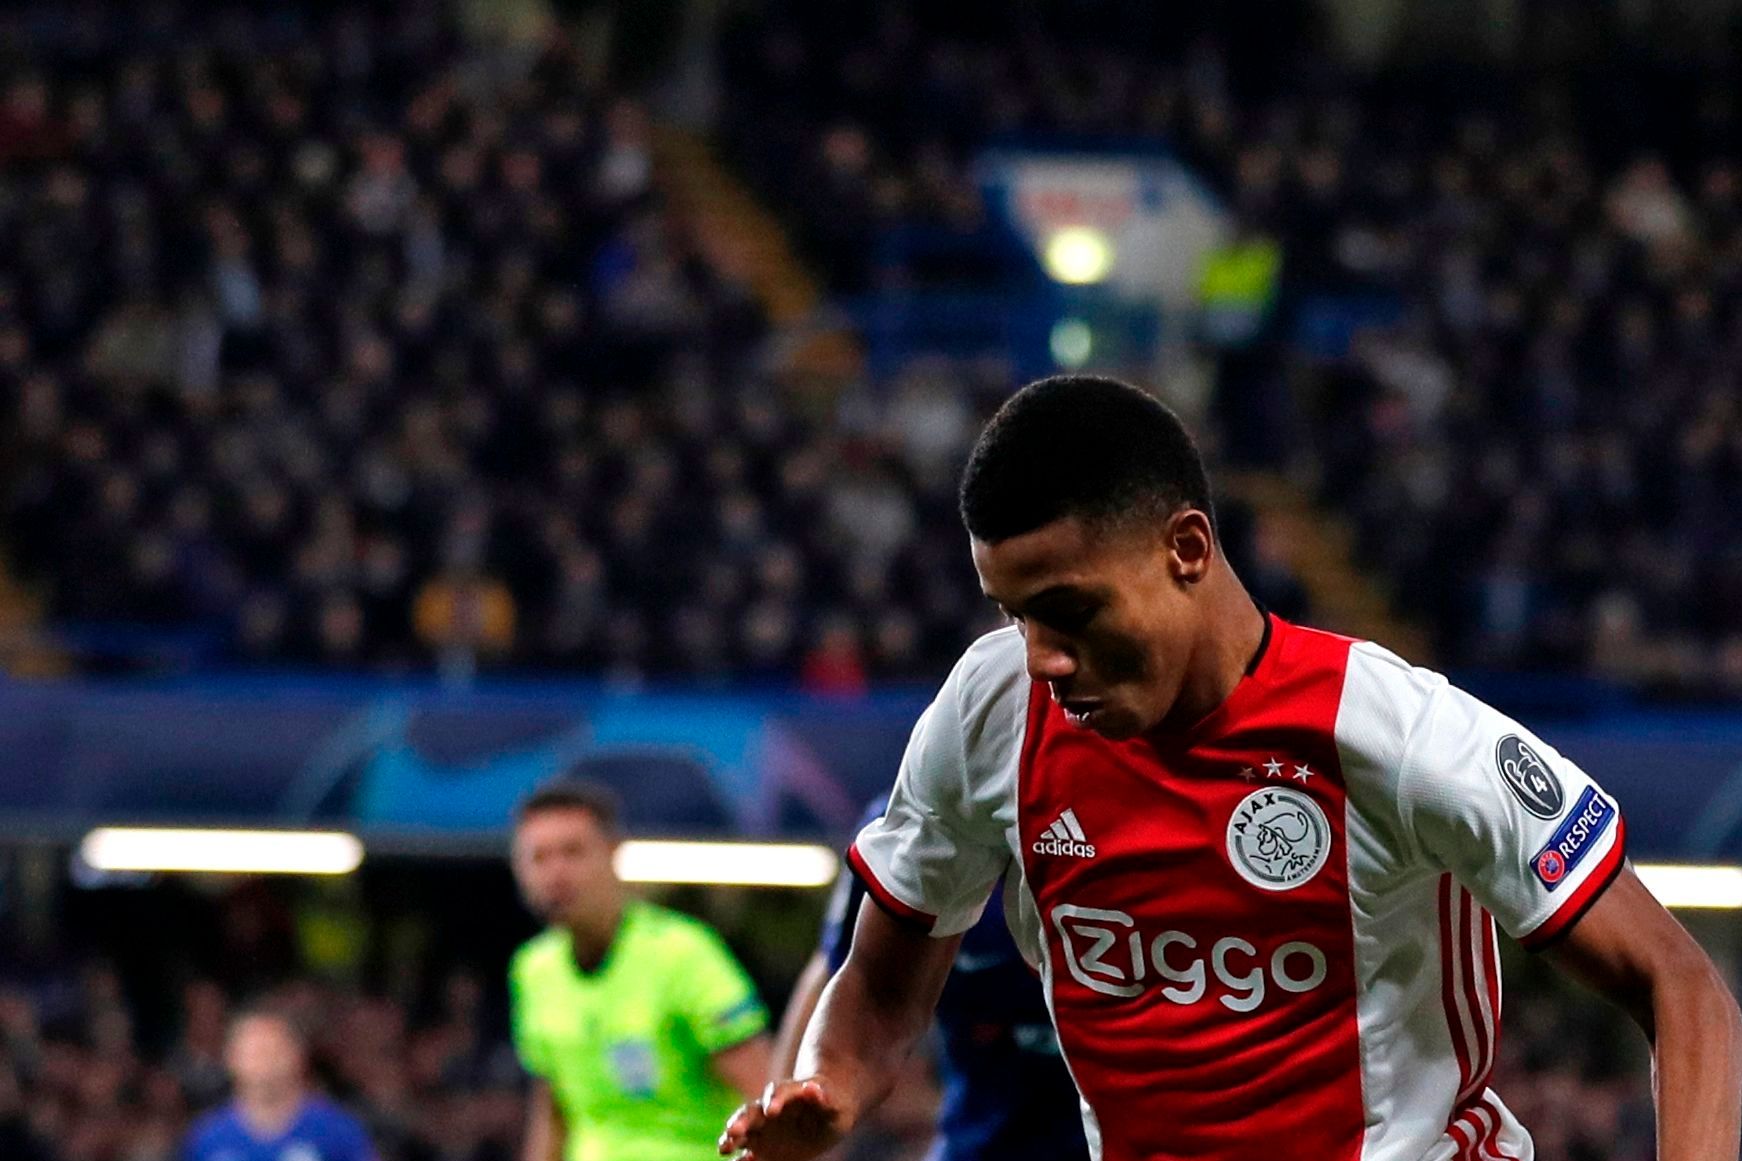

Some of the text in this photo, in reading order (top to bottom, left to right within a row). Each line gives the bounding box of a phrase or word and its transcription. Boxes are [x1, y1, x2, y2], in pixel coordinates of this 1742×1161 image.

[1530, 775, 1547, 793] 4
[1234, 793, 1276, 834] AJAX
[1558, 793, 1606, 860] RESPECT
[1032, 839, 1096, 858] adidas
[1051, 903, 1327, 1013] Ziggo
